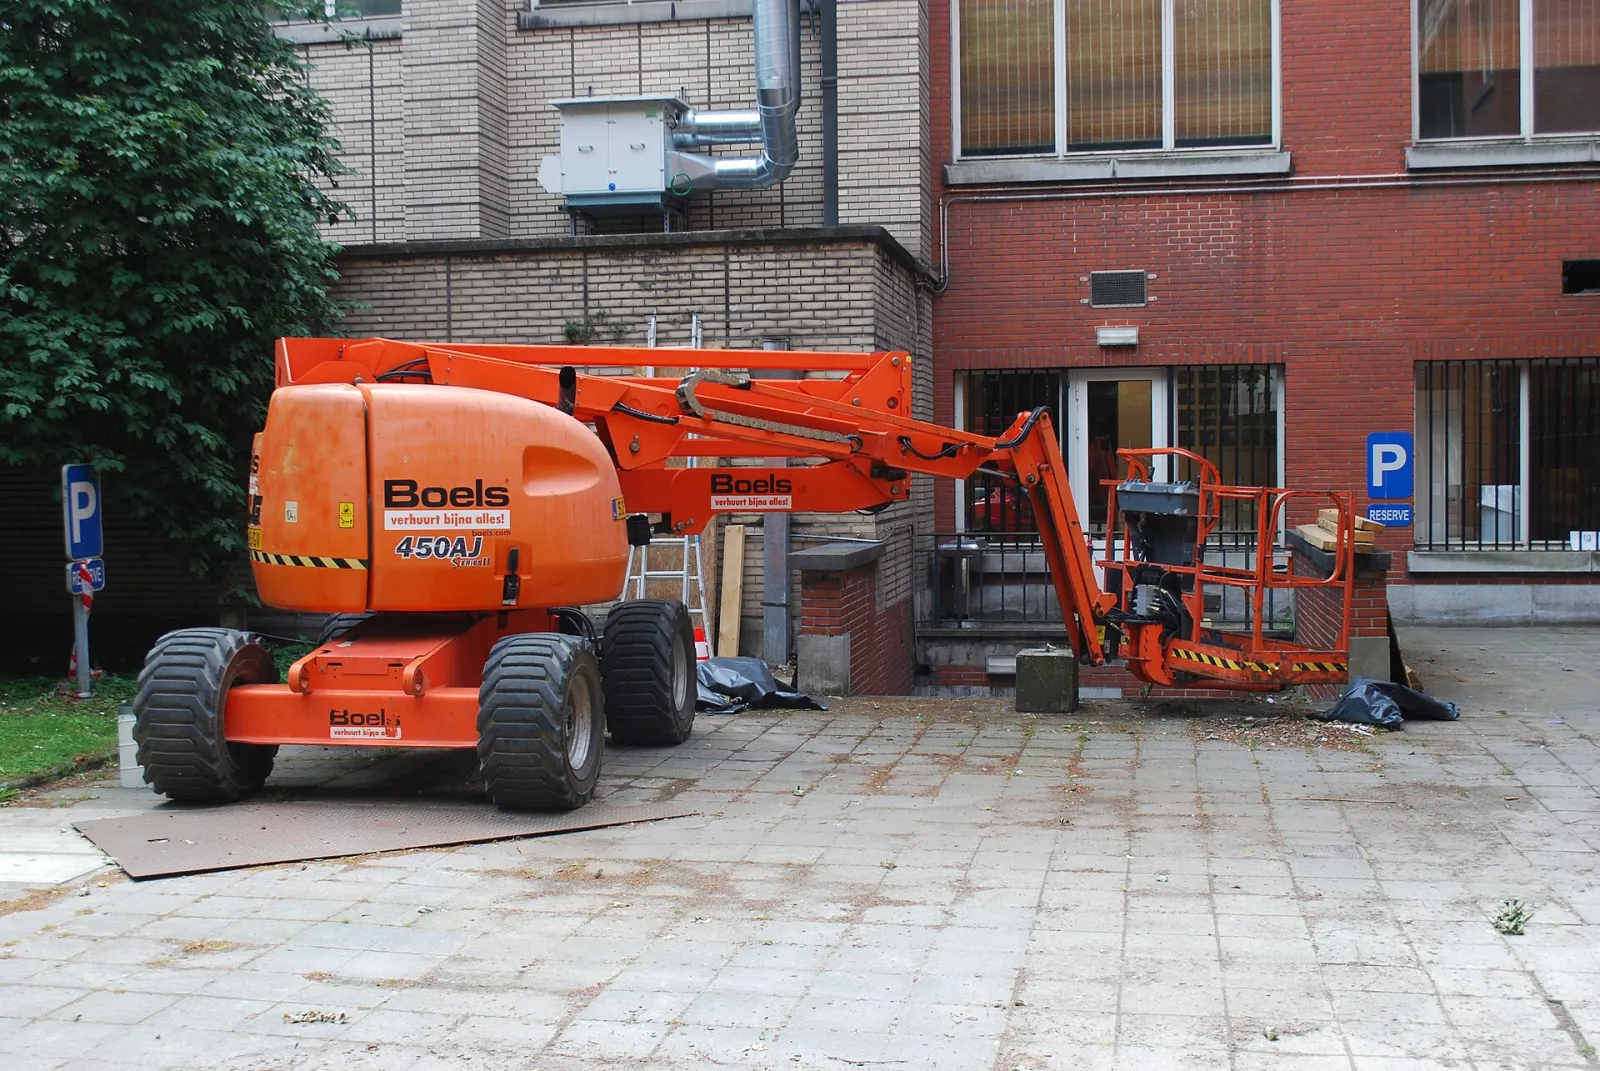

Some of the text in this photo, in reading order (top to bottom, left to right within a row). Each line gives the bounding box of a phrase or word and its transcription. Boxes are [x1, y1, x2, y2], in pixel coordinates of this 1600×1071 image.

[1372, 444, 1407, 487] P
[711, 474, 792, 493] Boels
[384, 479, 510, 508] Boels
[714, 497, 788, 507] verhuurt bijna alles!
[70, 481, 97, 543] P
[391, 513, 505, 527] verhuurt bijna alles!
[1369, 509, 1410, 521] RESERVE
[472, 529, 511, 537] boels.com
[395, 536, 483, 559] 450AJ
[333, 728, 361, 736] verhuurt
